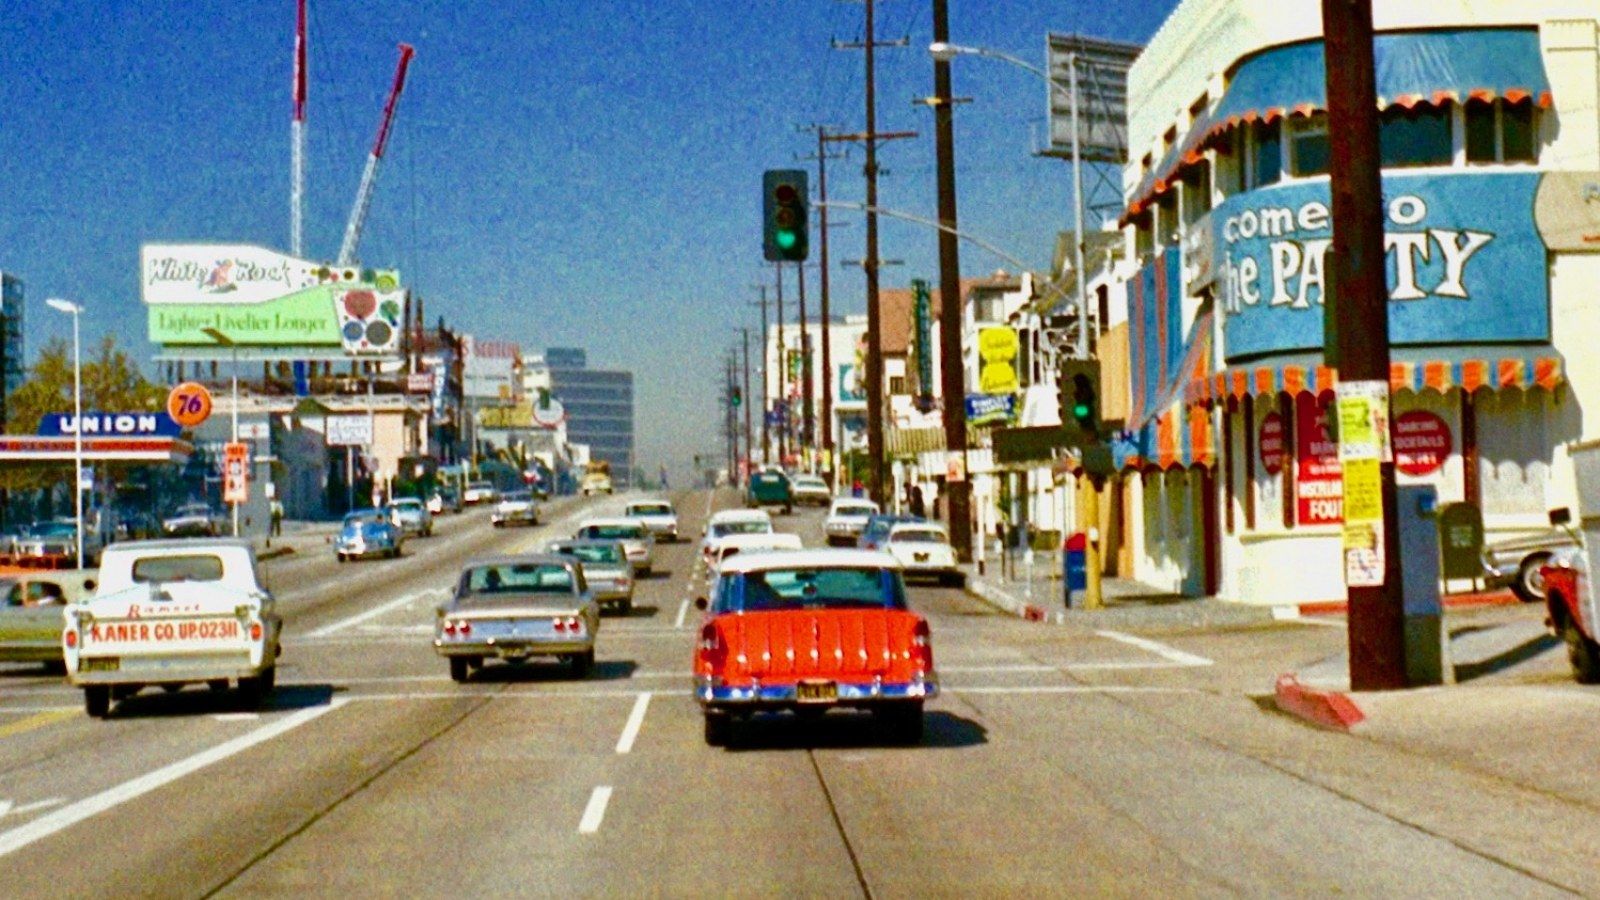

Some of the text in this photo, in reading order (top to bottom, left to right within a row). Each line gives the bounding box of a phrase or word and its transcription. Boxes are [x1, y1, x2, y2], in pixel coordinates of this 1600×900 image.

[1222, 195, 1427, 243] come o
[235, 257, 292, 288] Rock
[1270, 229, 1495, 308] PATY
[159, 313, 327, 333] Lighter Livelier Longer
[178, 394, 202, 416] 76
[59, 415, 156, 433] UNION
[91, 624, 149, 642] KANER
